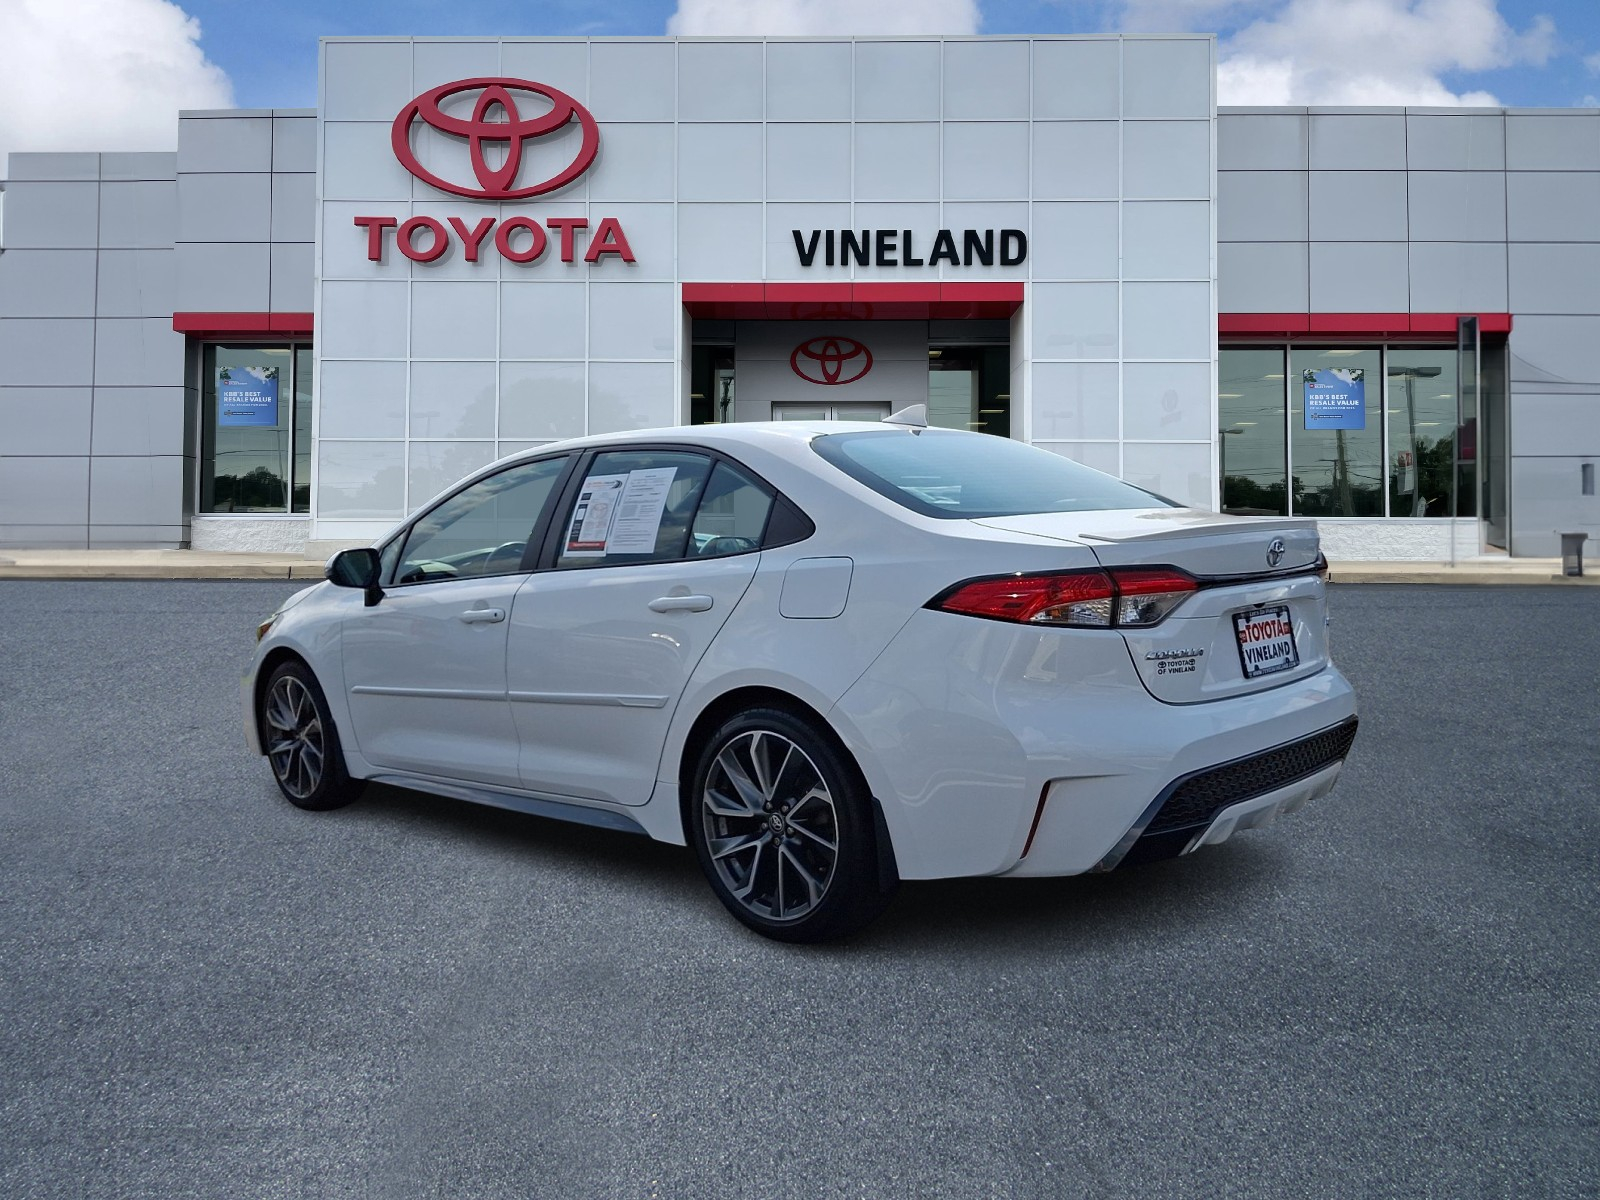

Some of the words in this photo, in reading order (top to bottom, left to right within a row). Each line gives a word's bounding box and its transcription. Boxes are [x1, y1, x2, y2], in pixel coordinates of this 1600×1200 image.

[354, 216, 636, 263] TOYOTA
[792, 229, 1028, 266] VINELAND
[1245, 619, 1285, 643] TOYOTA
[1245, 641, 1291, 664] VINELAND
[1168, 665, 1196, 674] VINELAND
